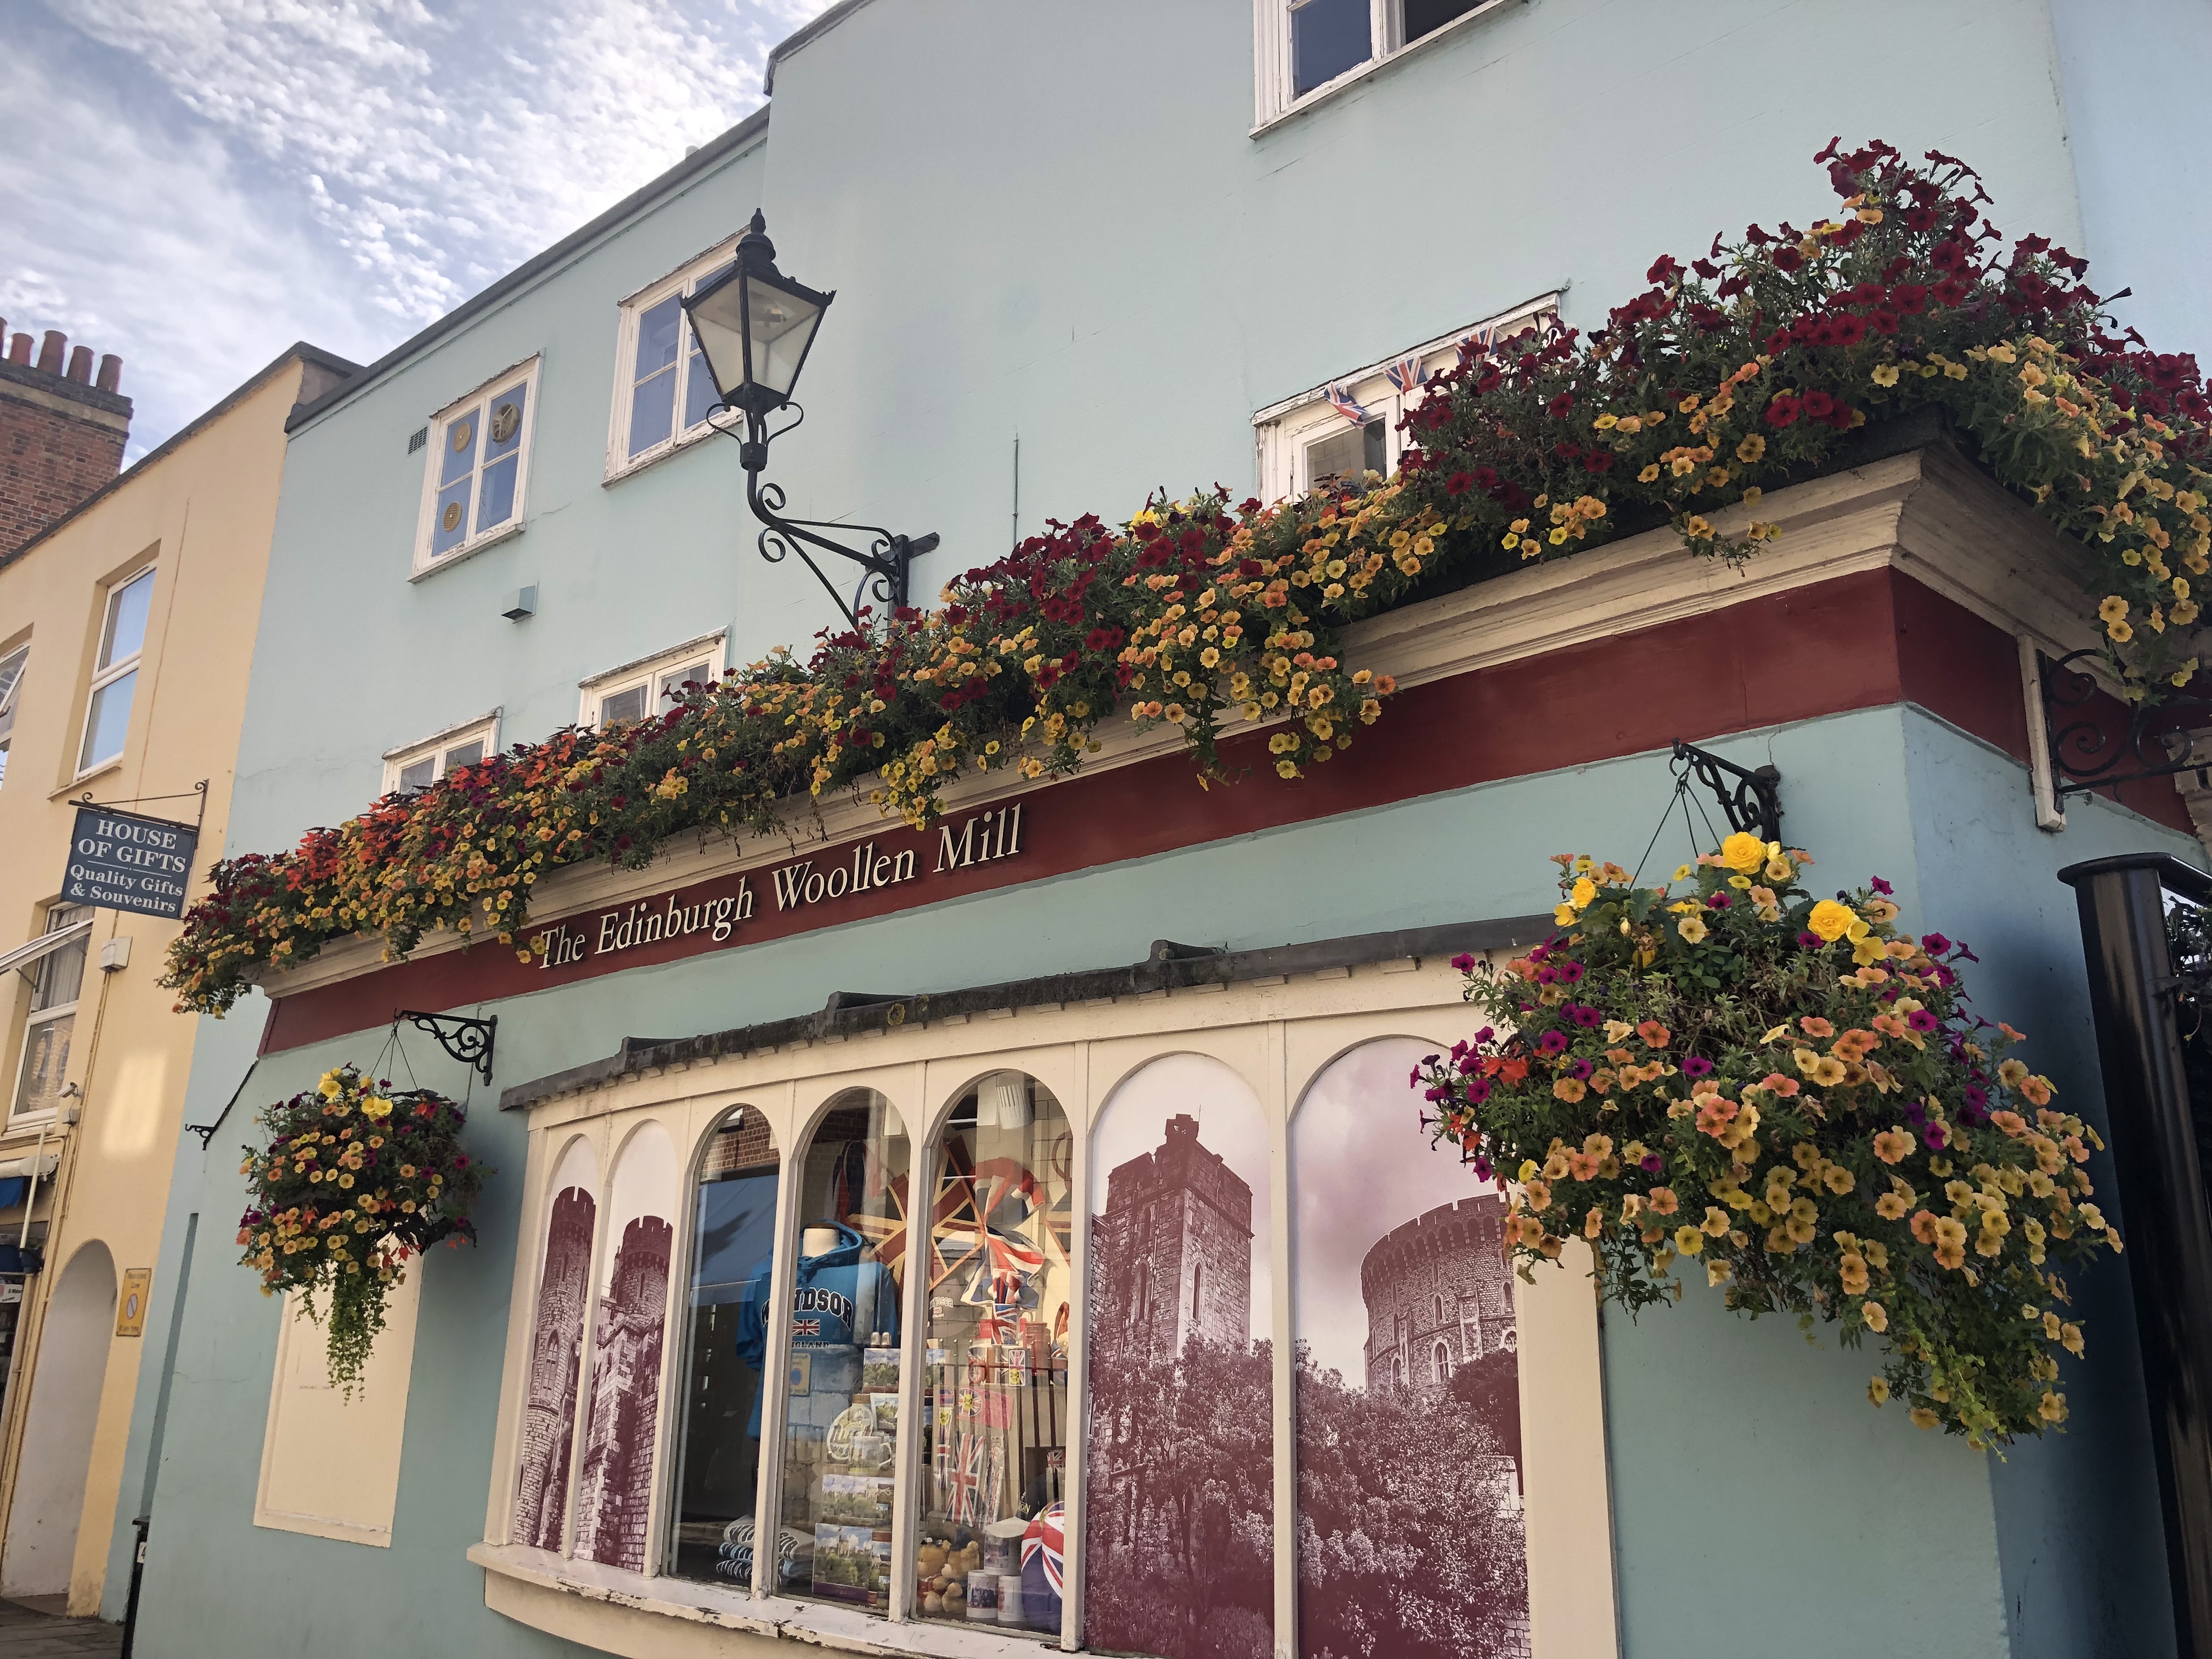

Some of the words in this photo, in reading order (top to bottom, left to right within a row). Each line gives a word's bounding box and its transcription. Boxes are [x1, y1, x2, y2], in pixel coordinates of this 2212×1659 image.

[96, 819, 177, 850] HOUSE
[78, 838, 112, 858] OF
[116, 846, 186, 873] GIFTS
[70, 864, 137, 890] Quality
[141, 877, 183, 896] Gifts
[539, 923, 586, 969] The
[594, 876, 754, 954] Edinburgh
[771, 842, 916, 911] Woollen
[933, 803, 1022, 873] Mill
[71, 883, 85, 897] &
[90, 886, 176, 912] Souvenirs
[761, 1287, 853, 1331] DSOR
